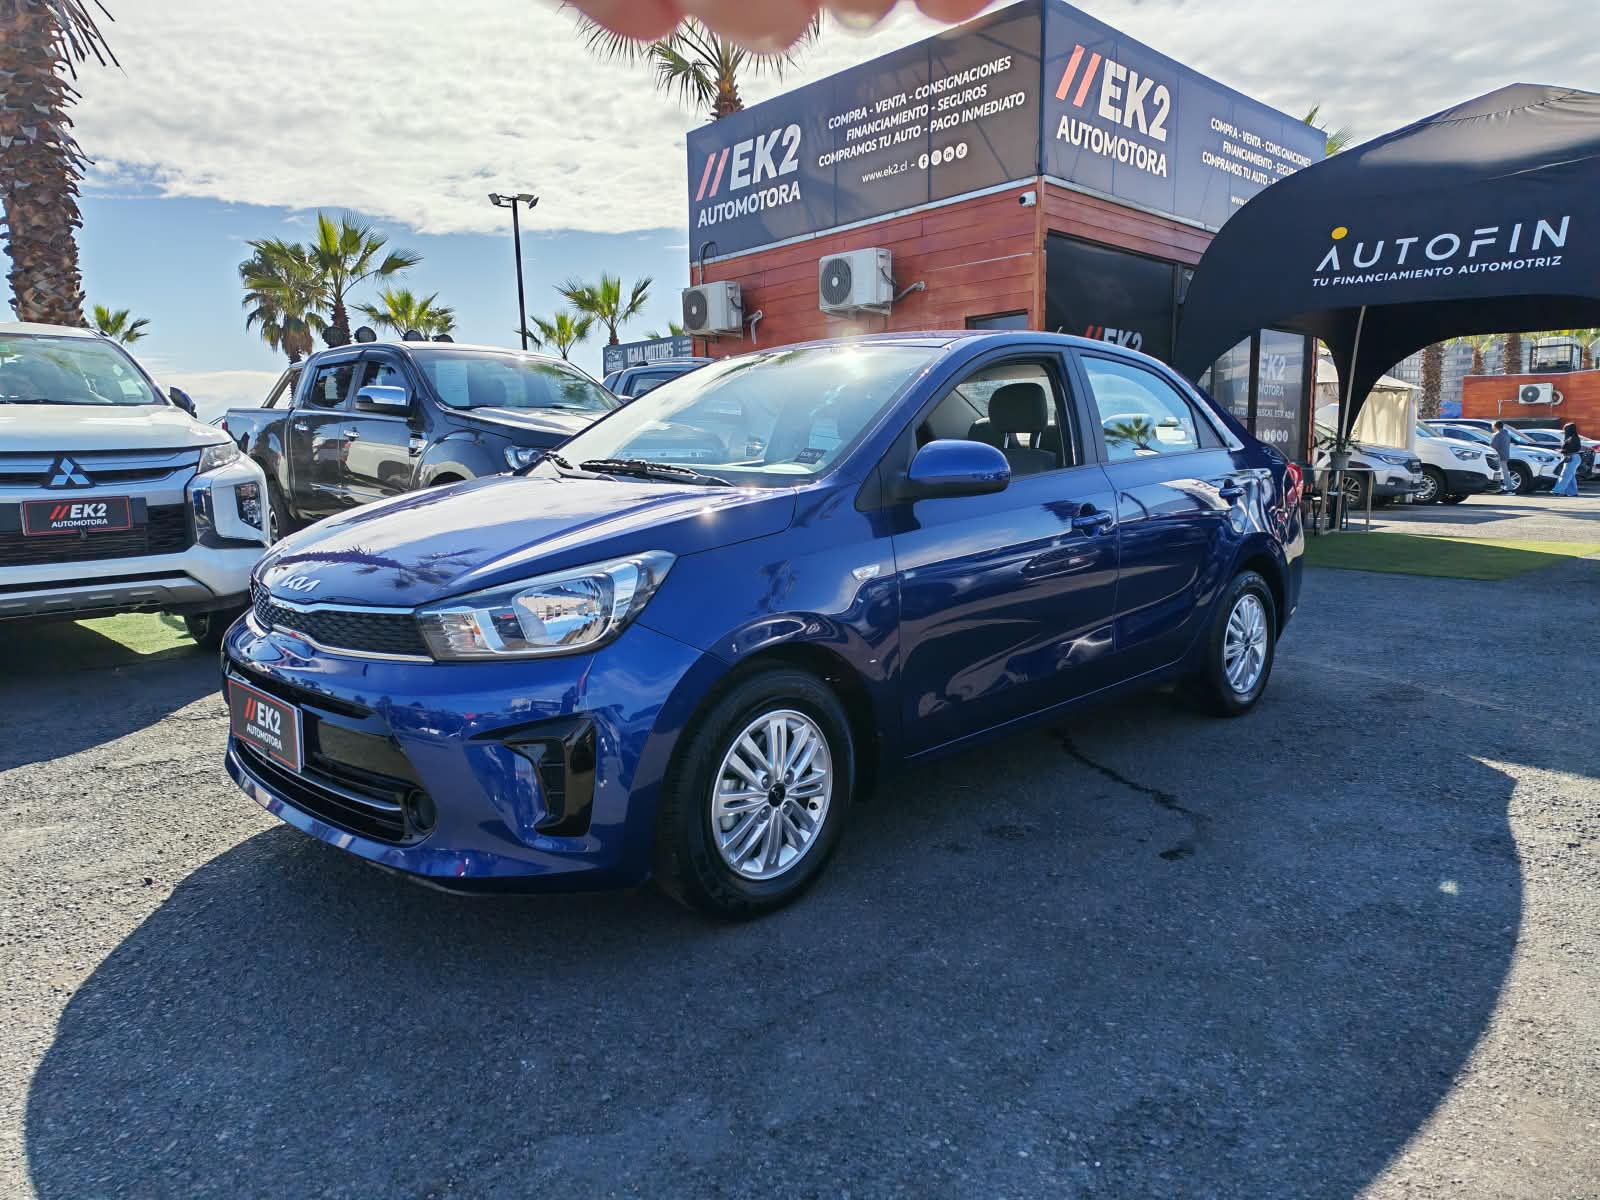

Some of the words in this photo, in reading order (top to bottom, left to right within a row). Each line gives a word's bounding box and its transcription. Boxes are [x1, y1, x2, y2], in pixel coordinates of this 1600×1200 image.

[828, 107, 868, 130] COMPRA
[875, 92, 907, 114] VENTA
[915, 55, 1012, 100] CONSIGNACIONES
[818, 138, 877, 168] COMPRAMOS
[879, 134, 892, 149] TU
[893, 125, 921, 145] AUTO
[930, 112, 960, 133] PAGO
[961, 91, 1026, 124] INMEDIATO
[846, 104, 929, 142] FINANCIAMIENTO
[937, 83, 988, 112] SEGUROS
[1056, 114, 1167, 178] AUTOMOTORA
[1210, 117, 1238, 140] COMPRA
[1242, 130, 1262, 150] VENTA
[861, 160, 908, 183] www.ek2.cl
[1202, 151, 1242, 178] COMPRAMOS
[1242, 168, 1252, 181] TU
[1251, 170, 1268, 187] AUTO
[1222, 140, 1273, 171] FINANCIAMIENTO
[697, 180, 801, 229] AUTOMOTORA
[1315, 215, 1571, 273] AUTOFIN
[1312, 277, 1330, 287] TU
[1332, 265, 1454, 286] FINANCIAMIENTO
[1458, 255, 1563, 275] AUTOMOTRIZ
[51, 518, 108, 528] AUTOMOTORA
[246, 723, 283, 752] AUTOMOTORA
